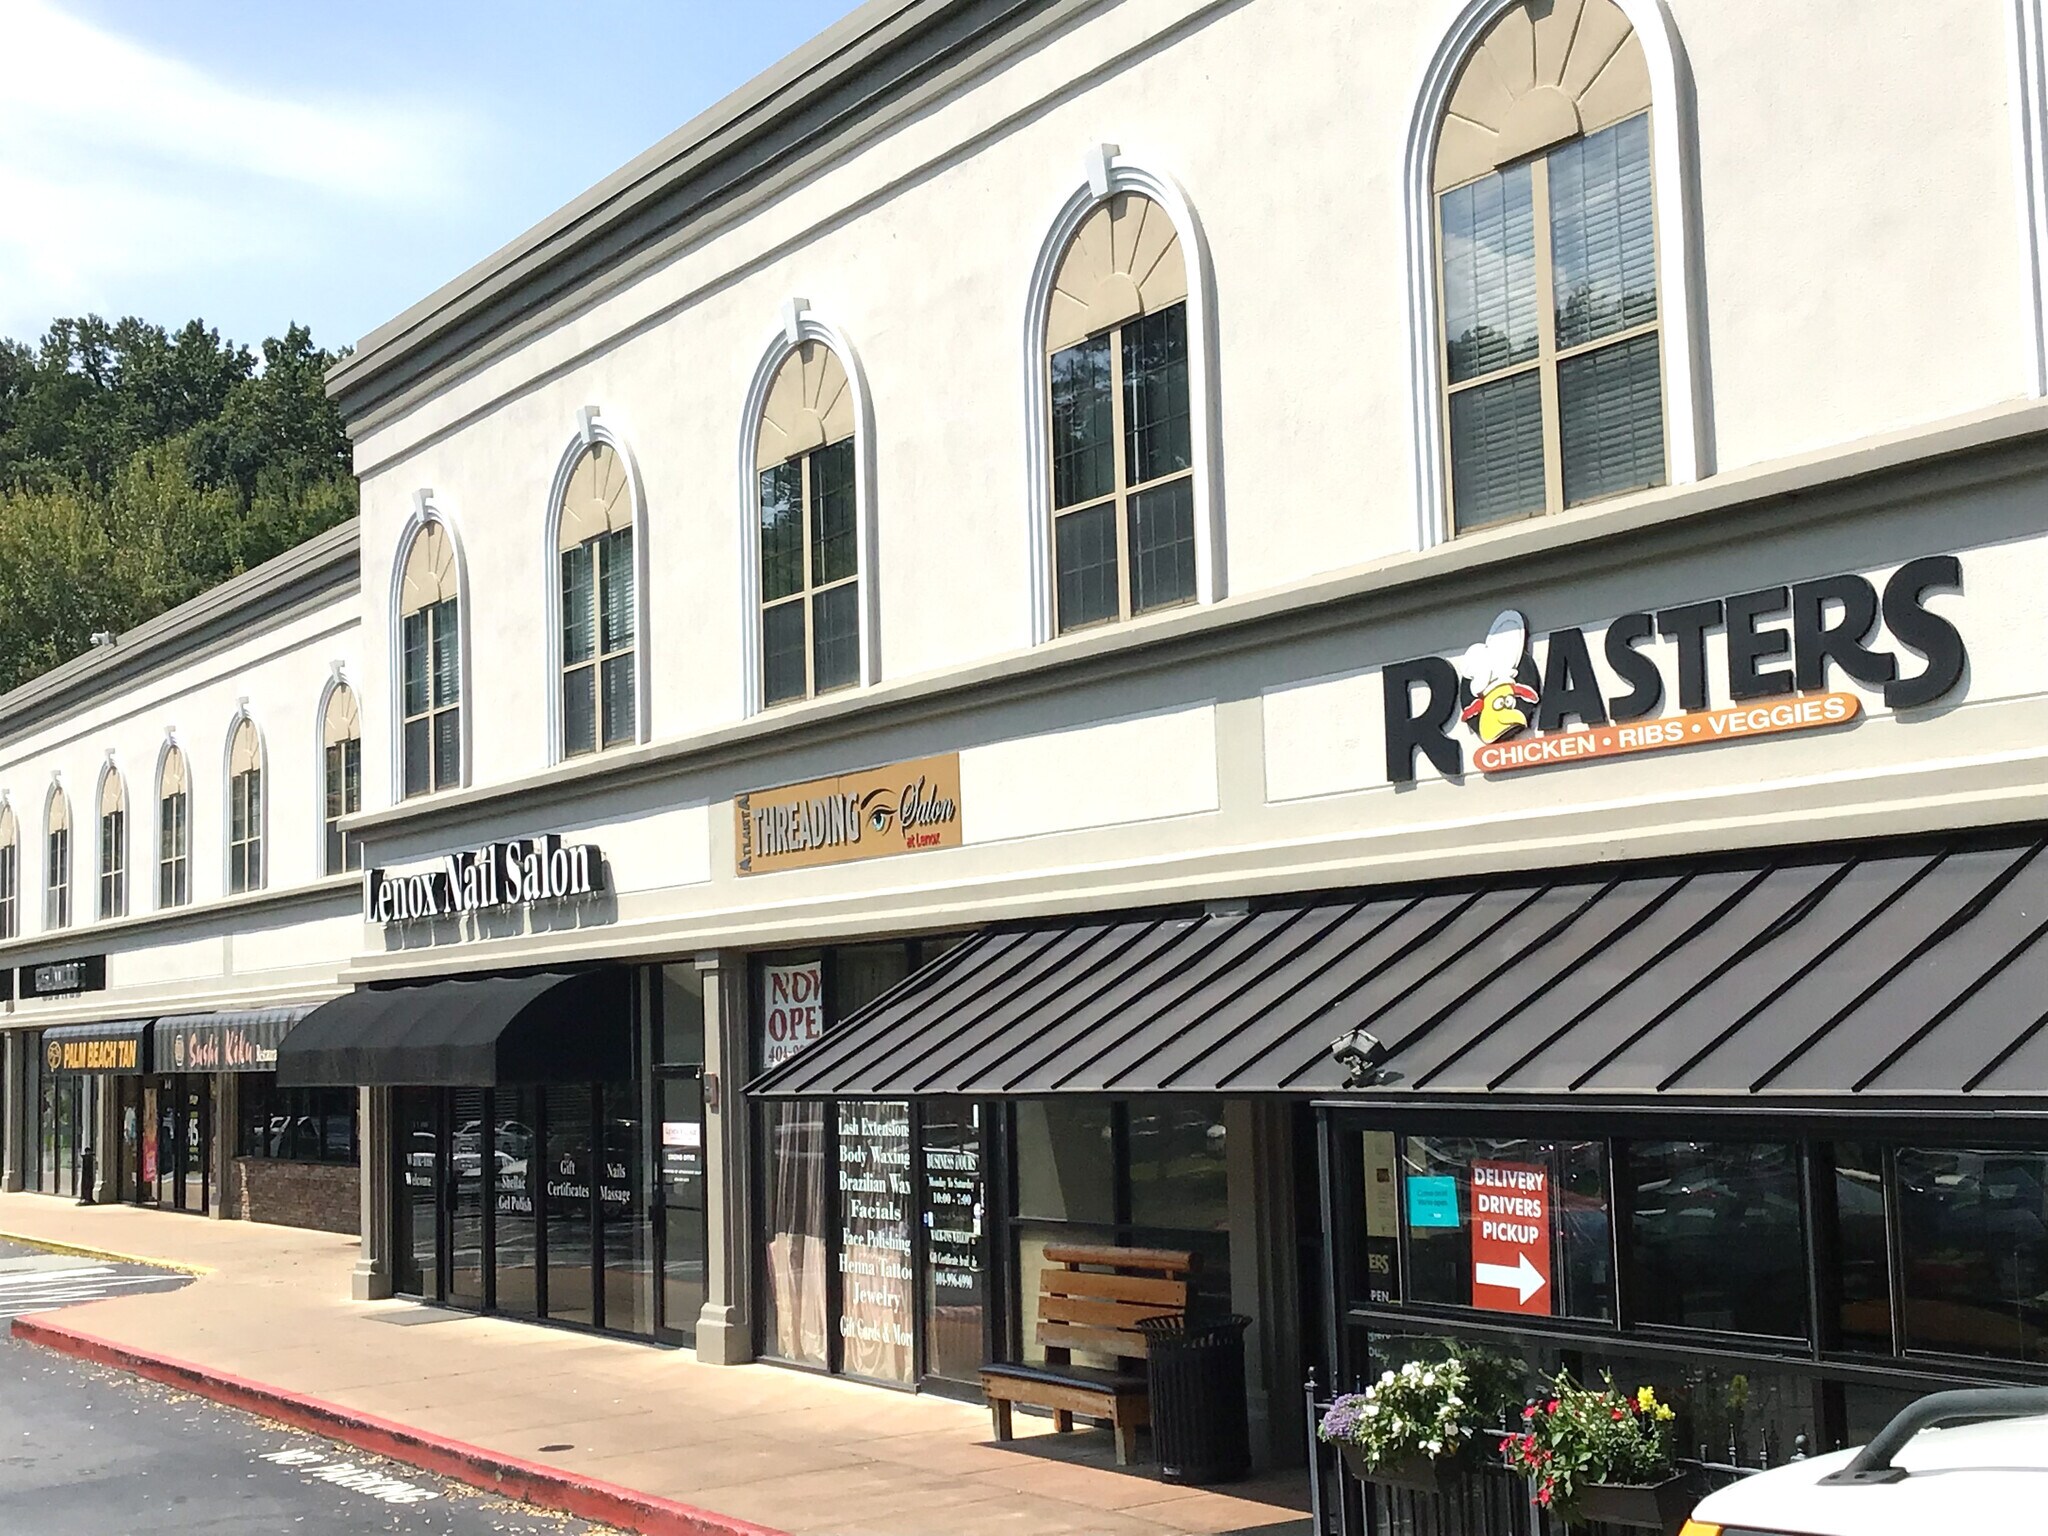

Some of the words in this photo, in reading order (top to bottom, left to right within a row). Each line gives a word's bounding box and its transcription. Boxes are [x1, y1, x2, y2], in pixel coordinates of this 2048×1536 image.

[1481, 734, 1597, 769] CHICKEN
[1619, 720, 1685, 750] RIBS
[1707, 696, 1848, 738] VEGGIES
[899, 774, 956, 840] Salon
[753, 791, 862, 858] THREADING
[364, 870, 438, 924] Lenox
[443, 842, 499, 914] Nail
[504, 833, 591, 905] Salon
[768, 1006, 823, 1043] OPE
[63, 1042, 87, 1069] PALM
[87, 1040, 117, 1068] BEACH
[118, 1039, 137, 1068] TAN
[188, 1032, 219, 1068] Sushi
[225, 1028, 253, 1067] Kiku
[838, 1116, 859, 1136] Lash
[560, 1160, 576, 1176] Gift
[839, 1144, 868, 1168] Body
[870, 1145, 911, 1171] Waxing
[606, 1162, 627, 1179] Nails
[839, 1170, 886, 1193] Brazilian
[889, 1173, 912, 1195] Wax
[1473, 1167, 1545, 1192] DELIVERY
[547, 1180, 590, 1198] Certificates
[600, 1185, 631, 1206] Massage
[498, 1194, 511, 1211] Gel
[511, 1195, 533, 1212] Polish
[850, 1199, 902, 1222] Facials
[1478, 1194, 1542, 1219] DRIVERS
[843, 1227, 865, 1246] Face
[866, 1229, 911, 1257] Polishing
[1482, 1221, 1539, 1246] PICKUP
[839, 1252, 875, 1276] Henna
[853, 1281, 901, 1314] Jewelry
